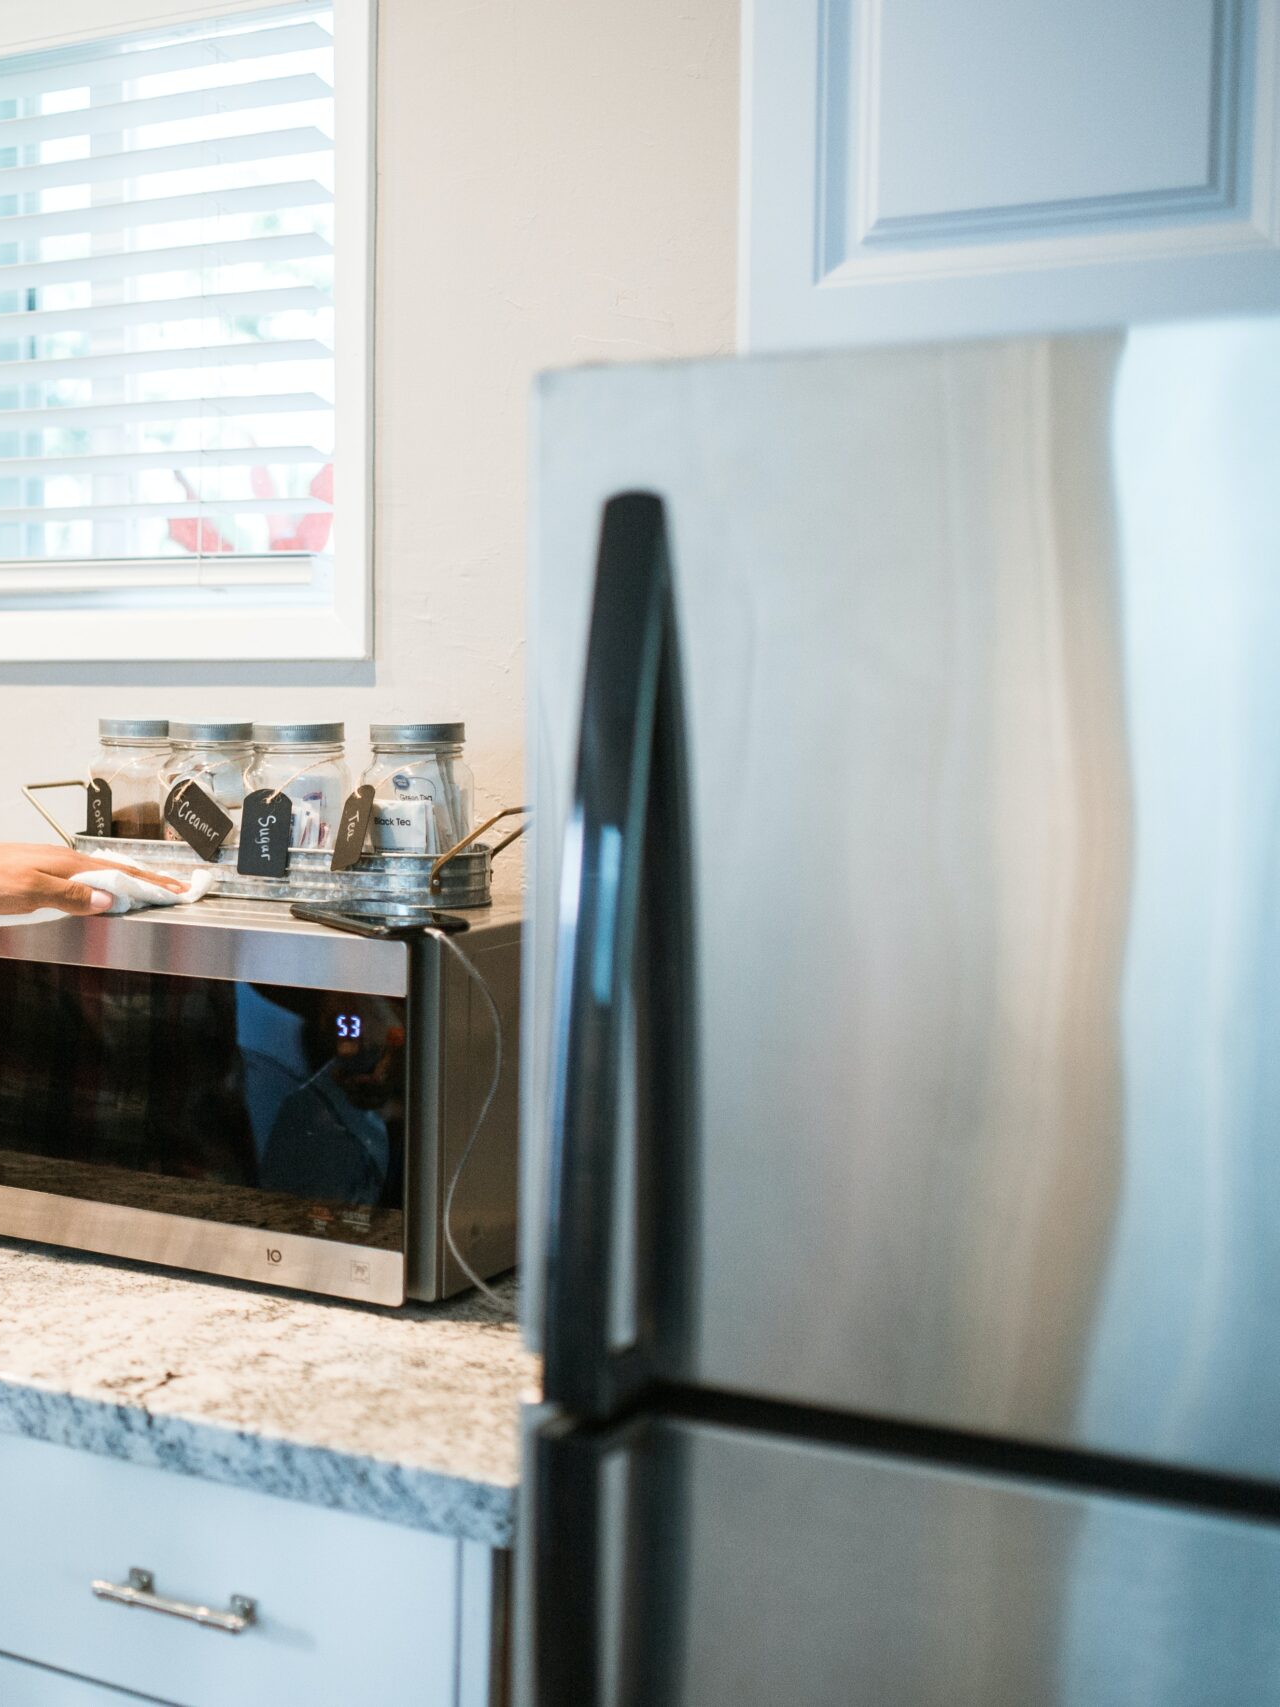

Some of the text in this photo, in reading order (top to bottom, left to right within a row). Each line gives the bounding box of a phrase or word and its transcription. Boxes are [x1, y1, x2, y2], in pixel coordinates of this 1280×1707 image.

[177, 800, 219, 841] Creamer
[347, 810, 360, 842] Tea
[374, 816, 411, 826] Black Tea
[255, 815, 277, 861] Sugar
[336, 1014, 361, 1038] 53
